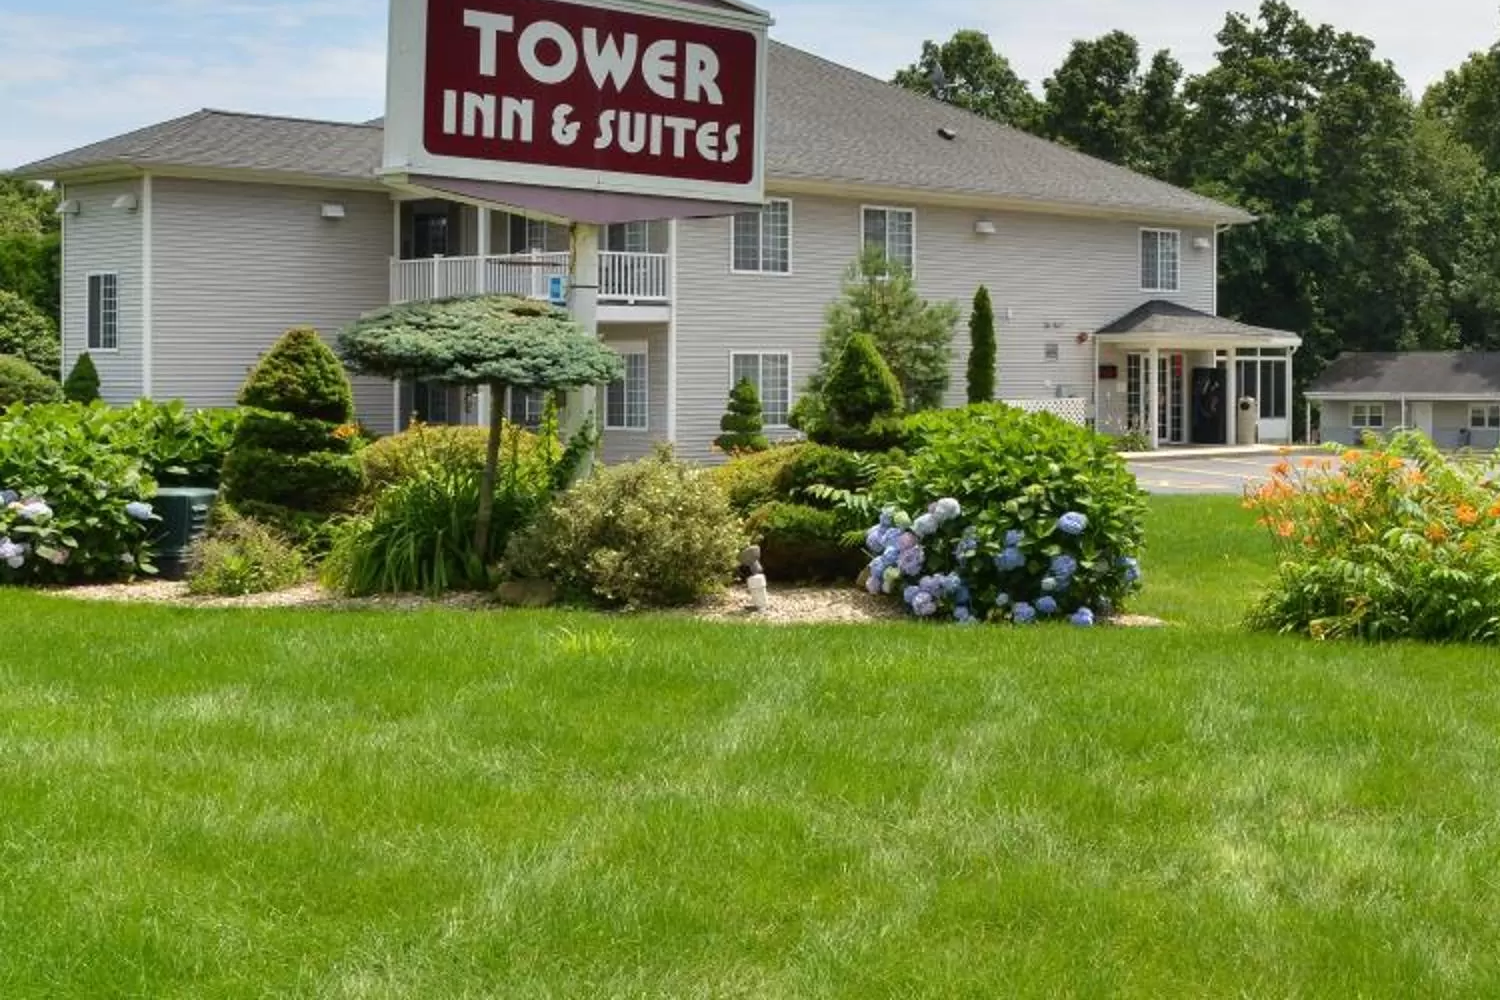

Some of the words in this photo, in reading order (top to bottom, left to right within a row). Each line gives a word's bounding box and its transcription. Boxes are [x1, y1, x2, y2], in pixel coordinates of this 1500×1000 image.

[463, 9, 724, 106] TOWER
[442, 89, 535, 144] INN
[550, 103, 582, 147] &
[593, 108, 742, 164] SUITES
